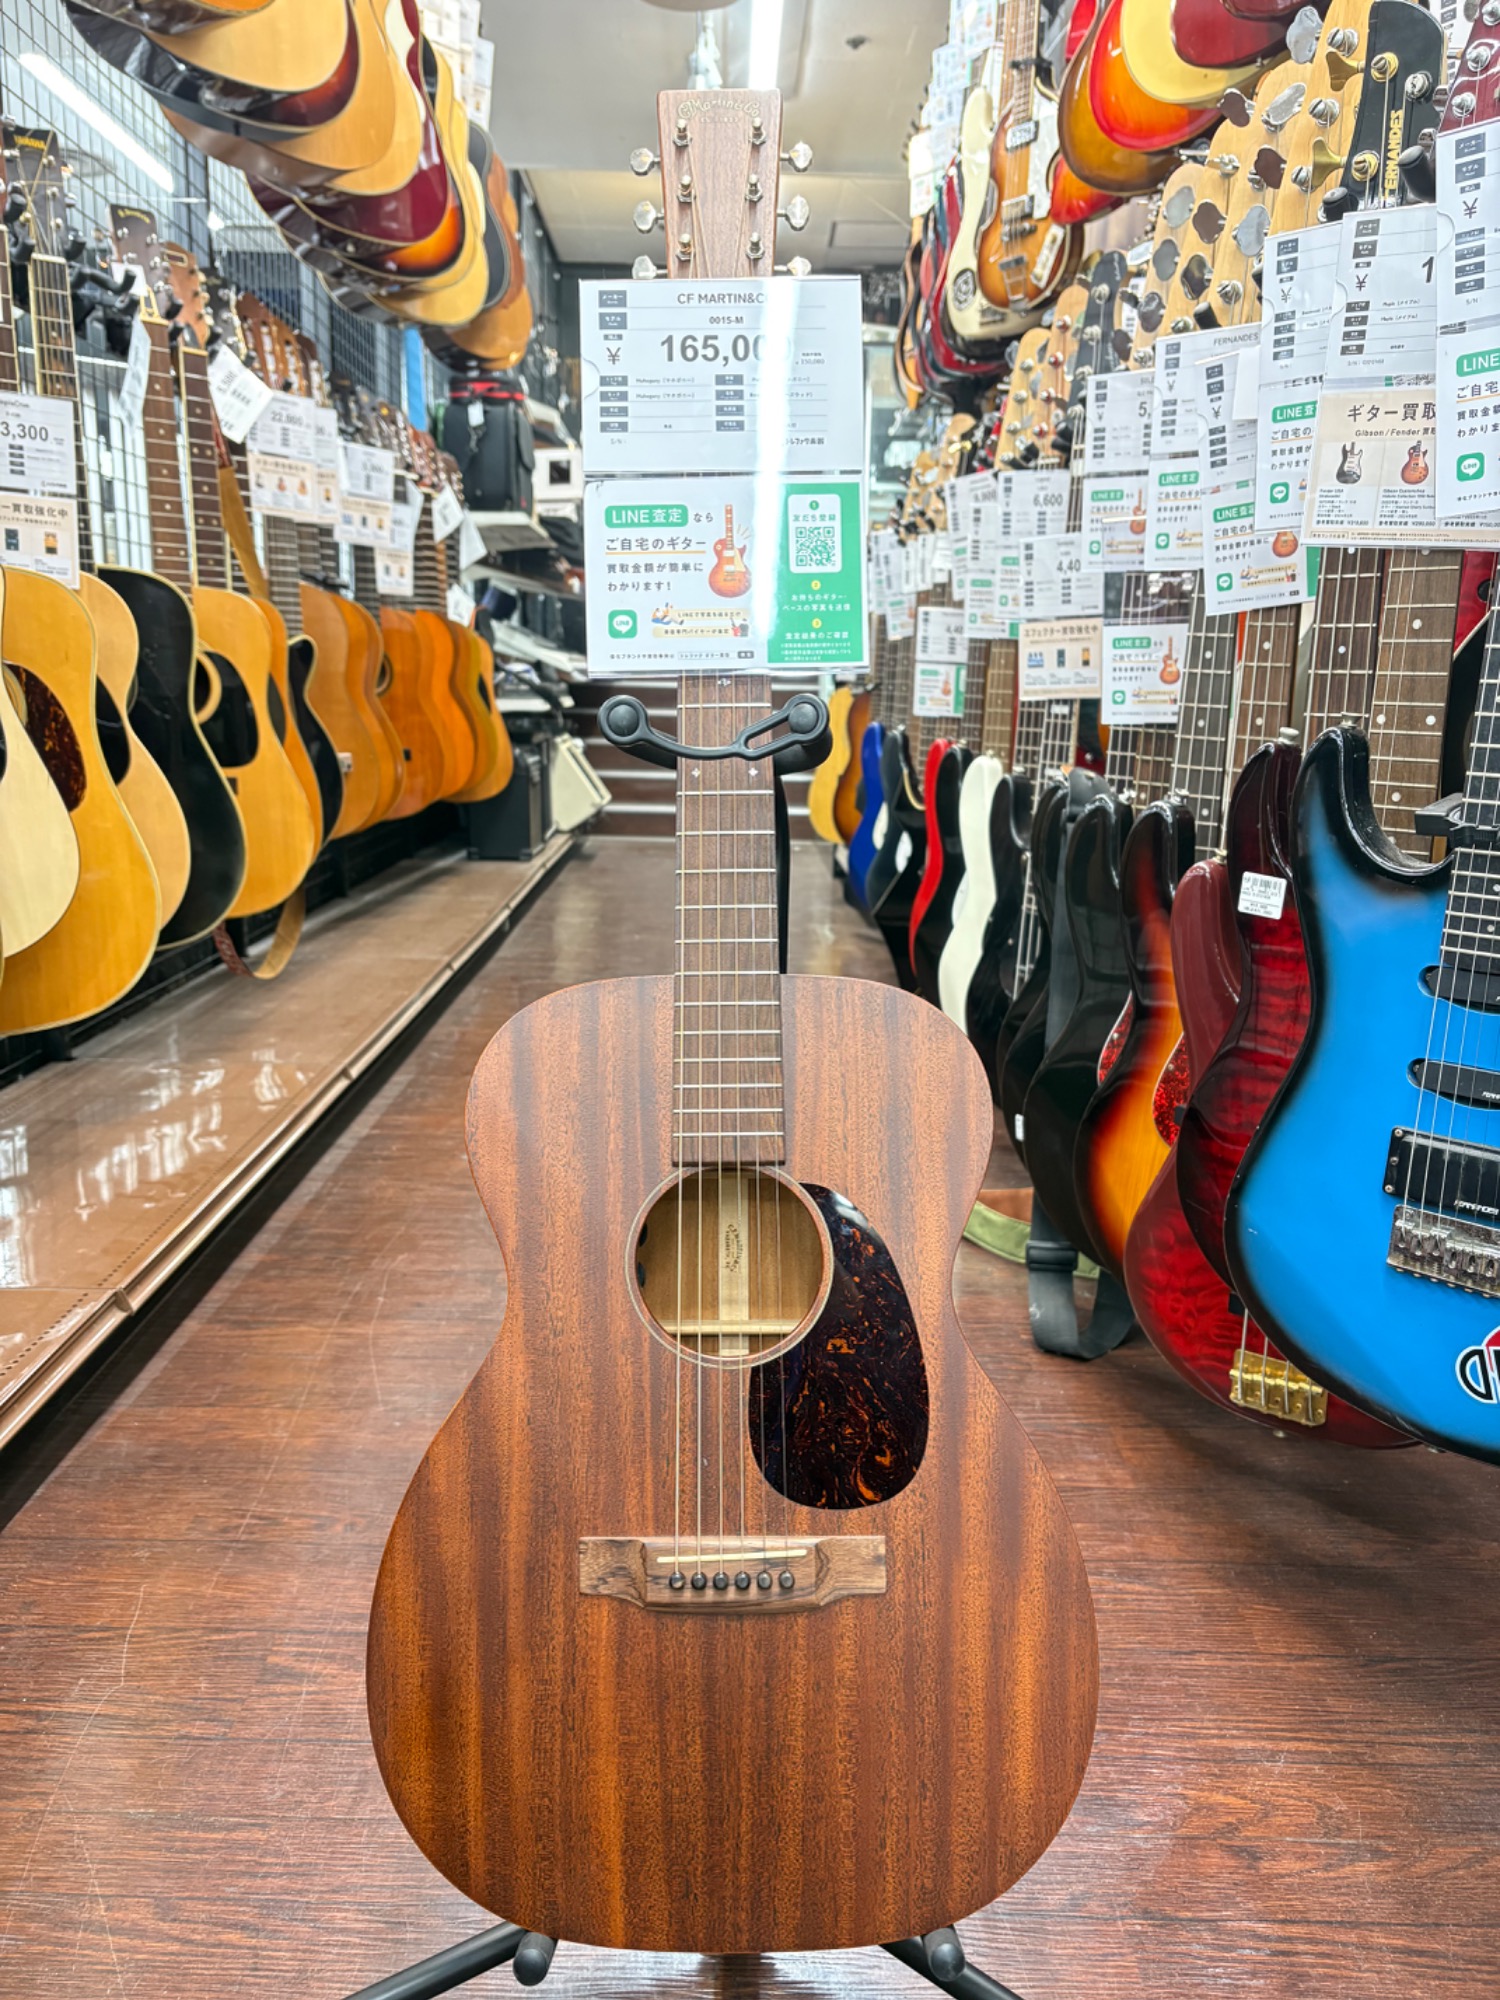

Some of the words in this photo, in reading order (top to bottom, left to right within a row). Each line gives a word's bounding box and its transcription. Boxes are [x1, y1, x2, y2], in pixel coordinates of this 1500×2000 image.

[1463, 197, 1478, 219] ¥
[1355, 274, 1368, 292] ¥
[677, 293, 695, 304] CF
[698, 293, 765, 305] MARTIN&C
[1213, 332, 1259, 347] FERNANDES
[606, 347, 621, 365] ¥
[1276, 405, 1316, 421] LINE査
[1033, 493, 1064, 508] 6,600
[693, 512, 714, 524] なら
[606, 537, 707, 551] ご自宅のギター
[607, 562, 704, 574] 買取金額が簡単に
[1056, 559, 1081, 575] 4,40
